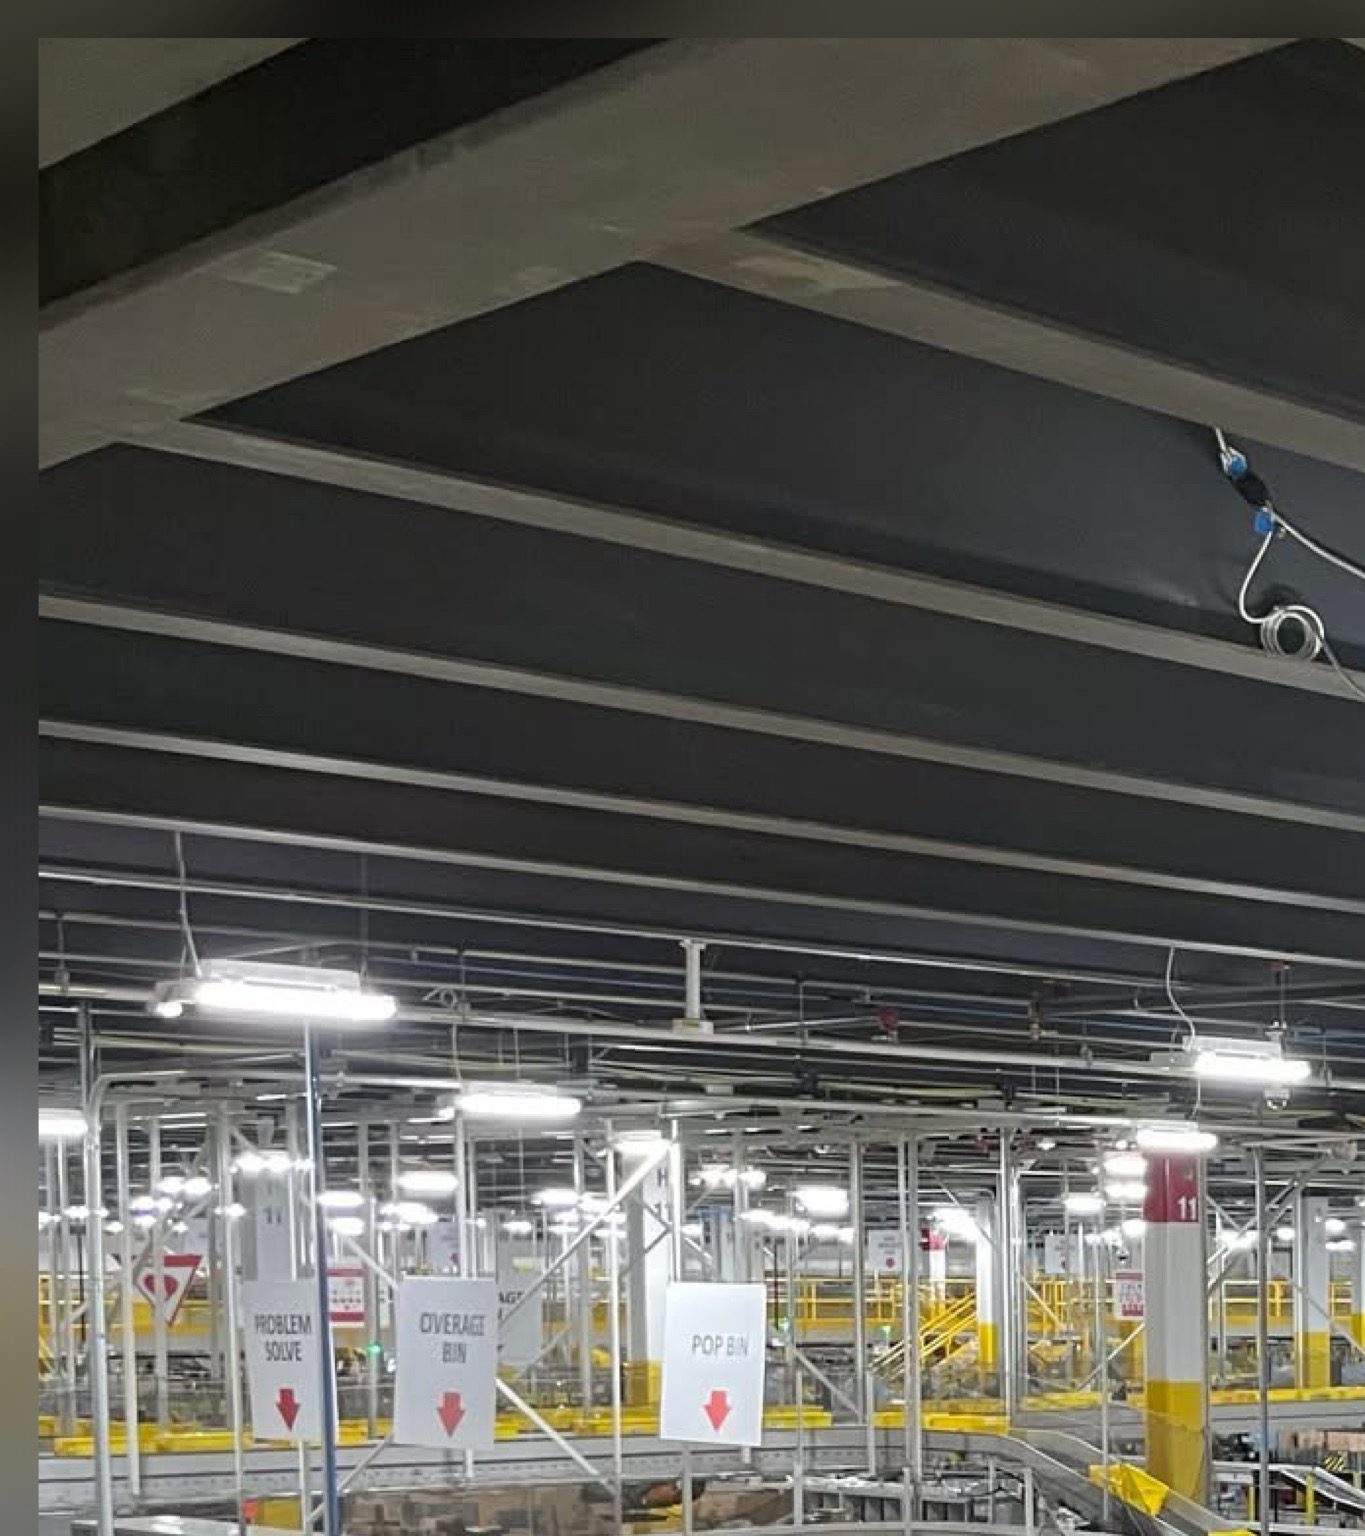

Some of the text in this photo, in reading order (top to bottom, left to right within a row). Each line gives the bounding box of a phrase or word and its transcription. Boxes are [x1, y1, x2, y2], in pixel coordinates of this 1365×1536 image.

[1178, 1196, 1197, 1221] 11
[254, 1314, 312, 1335] PROBLEM
[421, 1312, 486, 1337] OVERAGE
[265, 1341, 302, 1362] SOLVE
[442, 1343, 477, 1363] BIN
[692, 1334, 723, 1355] POP
